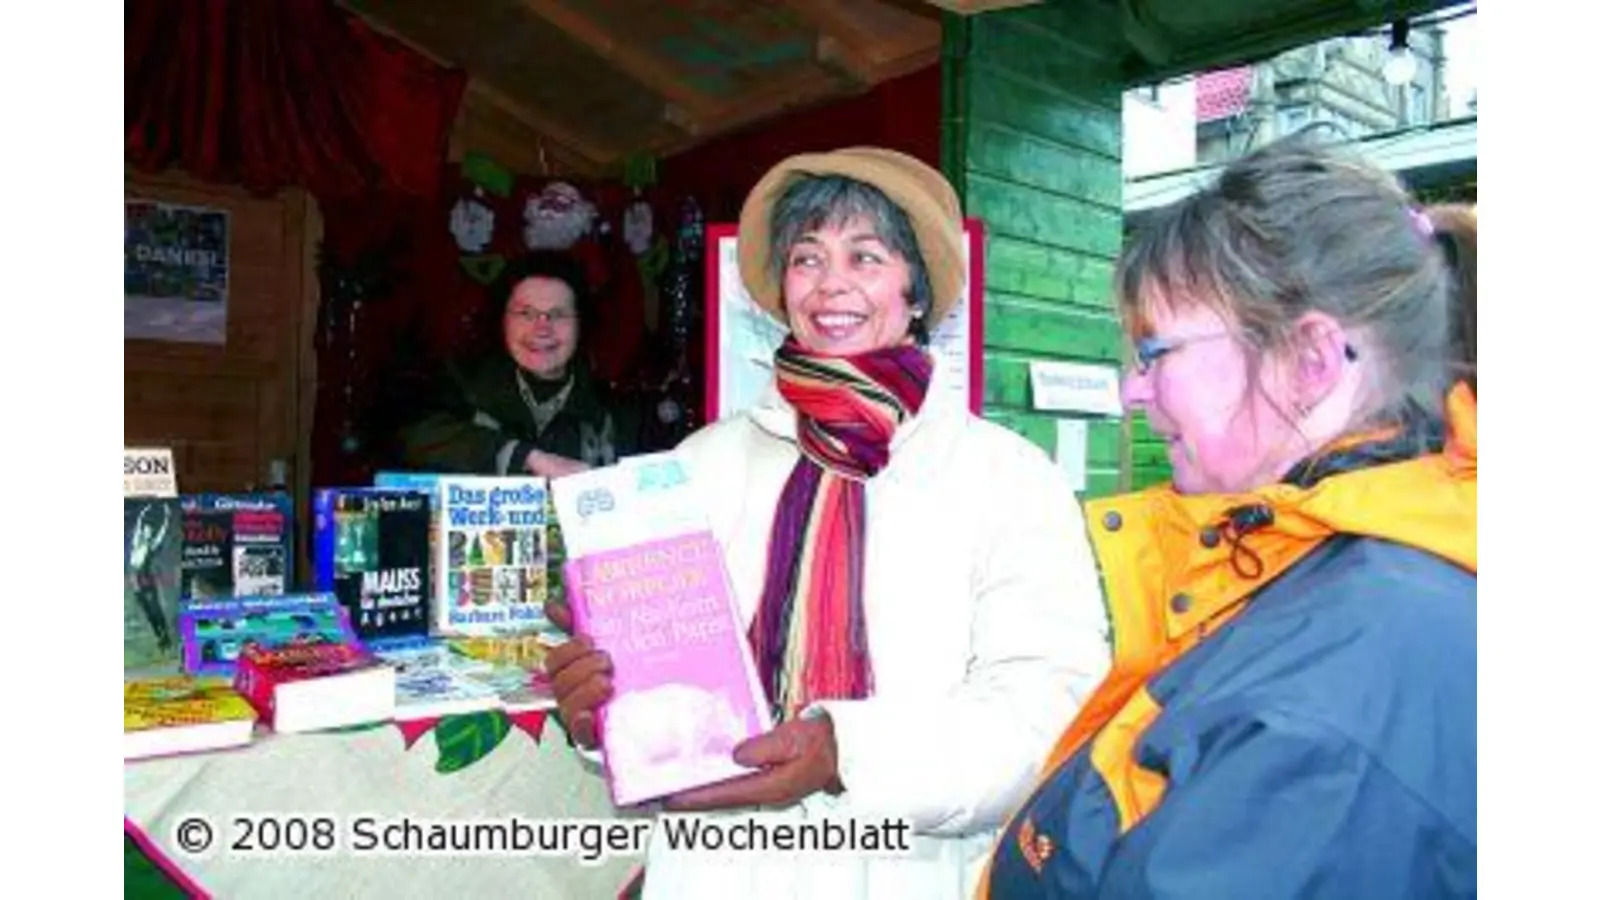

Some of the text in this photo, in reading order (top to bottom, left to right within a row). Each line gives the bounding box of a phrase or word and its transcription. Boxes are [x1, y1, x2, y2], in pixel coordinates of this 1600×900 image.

[449, 483, 546, 508] Das große
[508, 508, 546, 526] und
[362, 567, 422, 595] MAUSS
